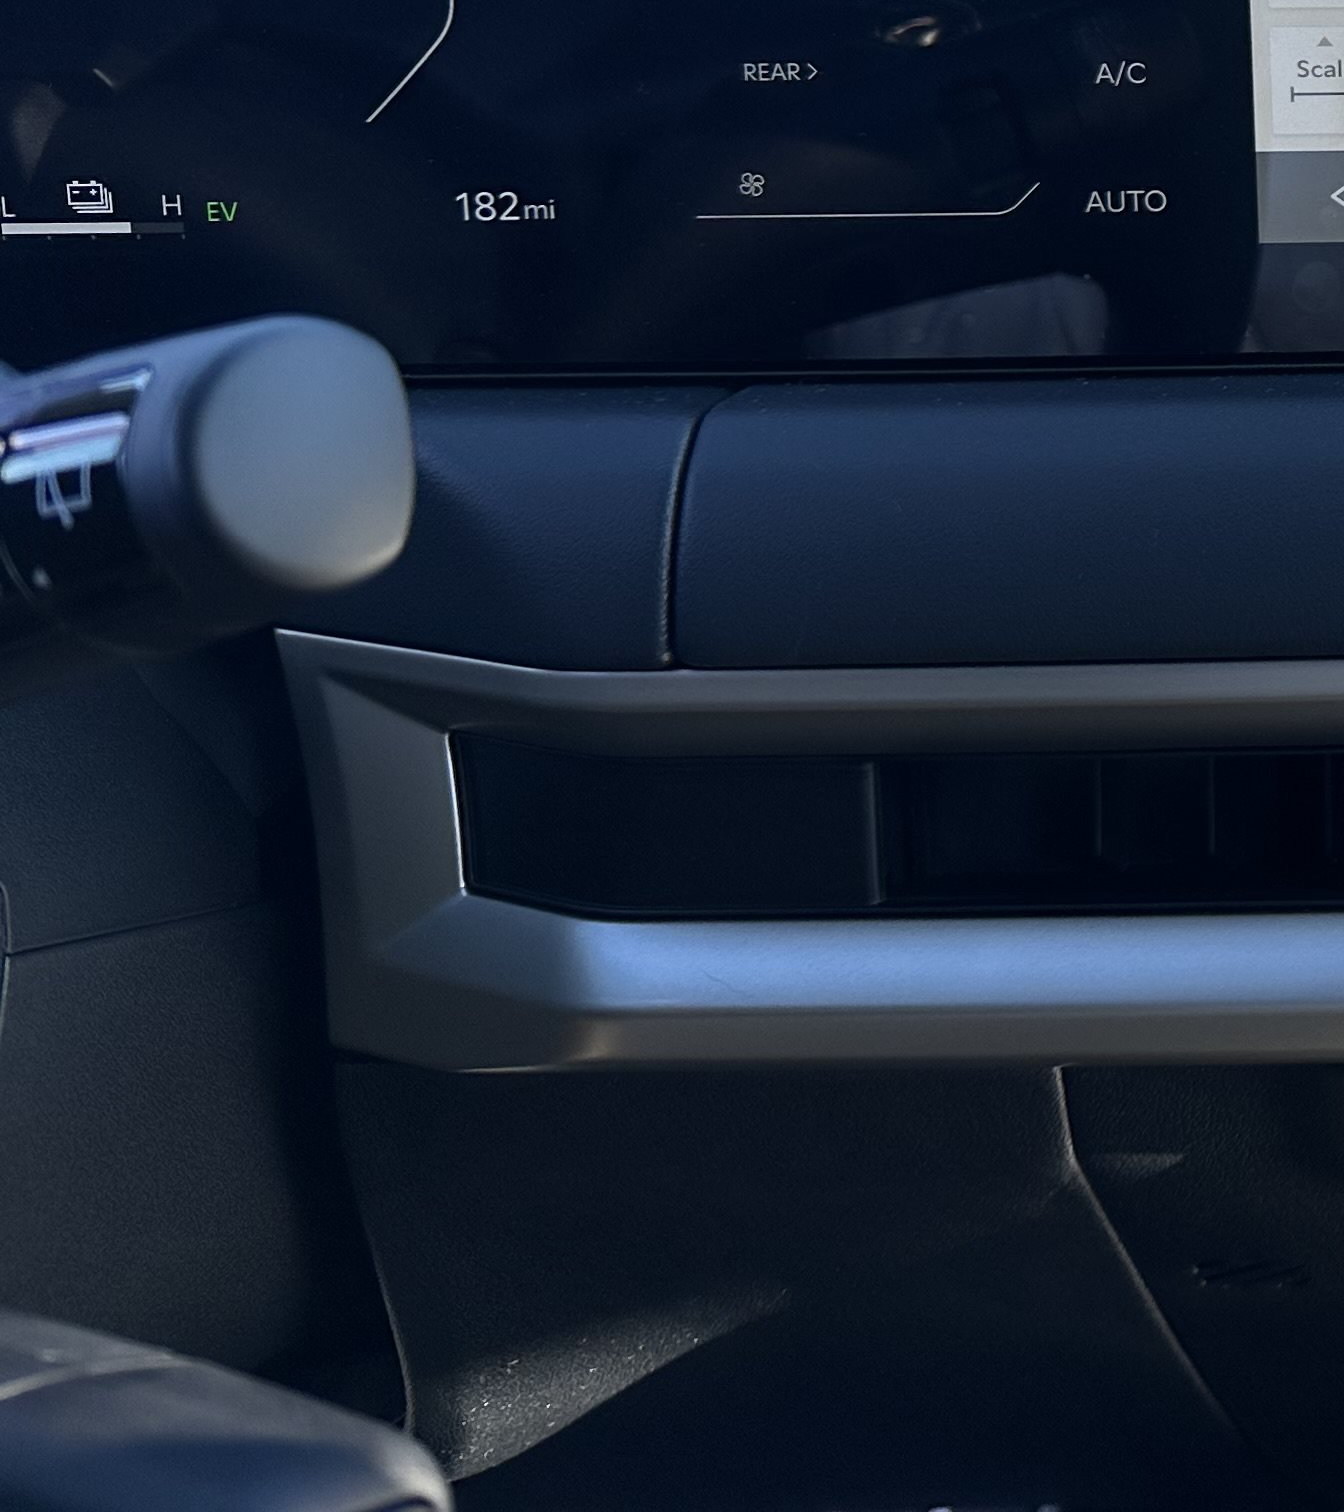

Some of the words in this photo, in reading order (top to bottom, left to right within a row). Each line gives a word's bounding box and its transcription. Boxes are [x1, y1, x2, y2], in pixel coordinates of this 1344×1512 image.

[743, 63, 801, 82] REAR
[1095, 61, 1148, 86] A/C
[1, 196, 16, 218] L
[161, 195, 182, 217] H
[206, 201, 238, 223] EV
[1084, 190, 1168, 213] AUTO
